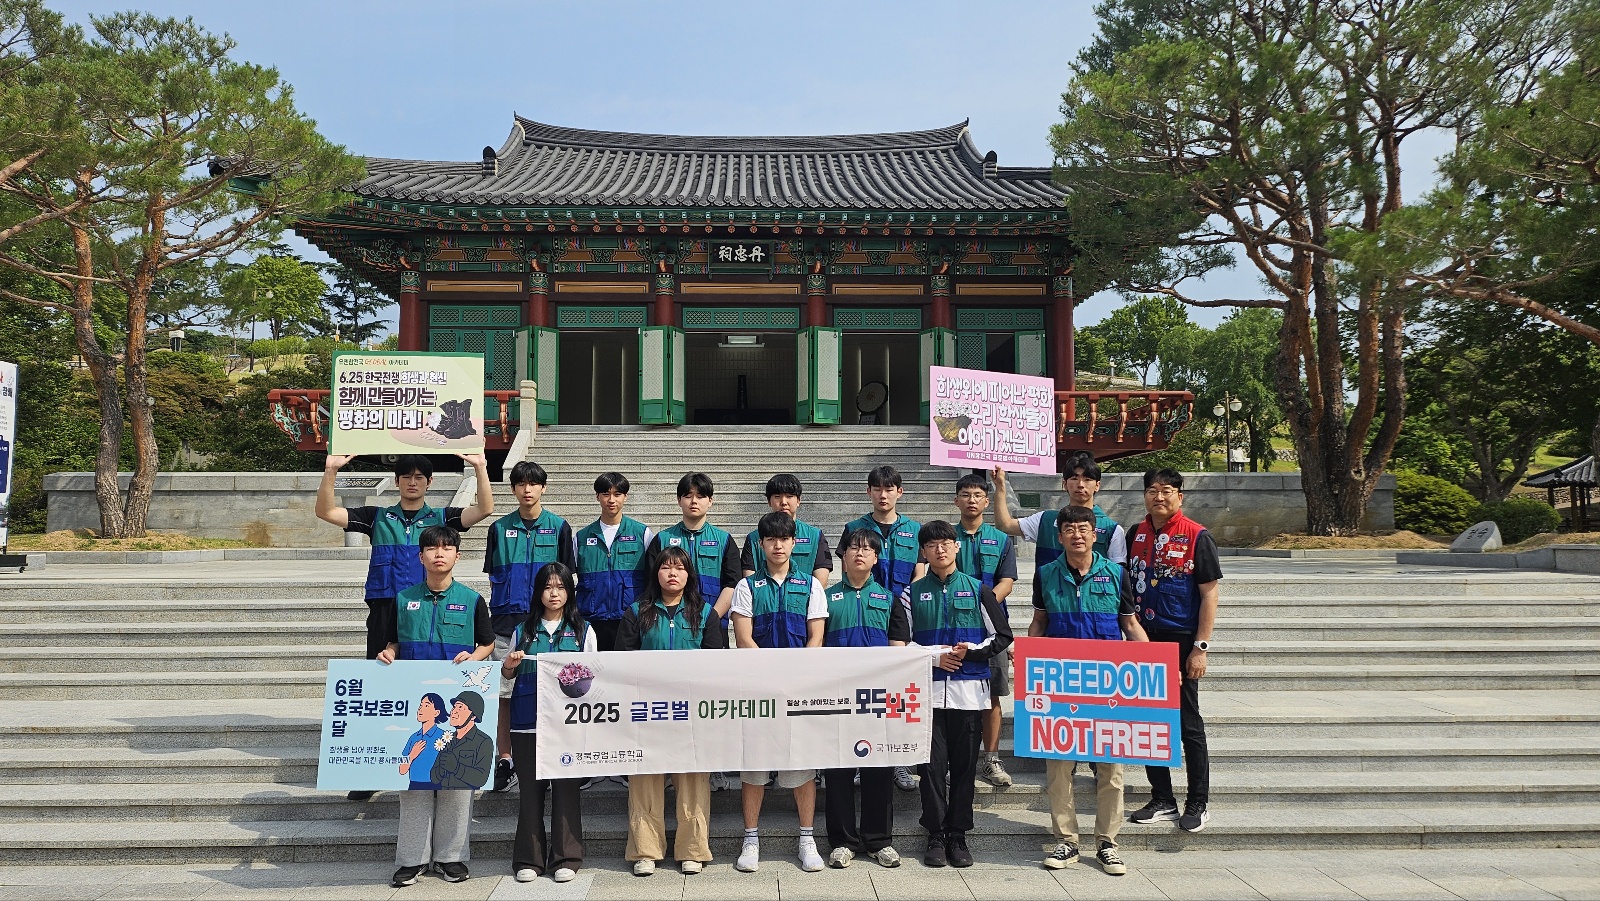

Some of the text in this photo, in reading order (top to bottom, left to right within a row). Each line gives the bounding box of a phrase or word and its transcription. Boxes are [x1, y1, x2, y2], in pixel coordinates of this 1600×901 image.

[340, 372, 362, 384] 6.25
[365, 372, 400, 384] 한국전쟁
[401, 371, 428, 385] 희생과
[339, 387, 437, 407] 함께 만들어가는
[338, 410, 424, 430] 평화의 미래!
[968, 402, 1053, 432] 우리 학생들이
[958, 424, 1055, 457] 이어가겠습니다.
[335, 679, 363, 697] 6월
[1026, 658, 1167, 700] FREEDOM
[333, 700, 409, 717] 호국보훈의
[564, 699, 776, 724] 2025 글로벌 아카데미
[1032, 698, 1043, 709] IS
[332, 720, 347, 738] 달
[1030, 715, 1171, 760] NOT FREE
[575, 750, 644, 761] 경북공업고등학교
[876, 744, 918, 753] 국가보훈부
[328, 756, 362, 764] 대한민국을
[363, 756, 378, 764] 지킨
